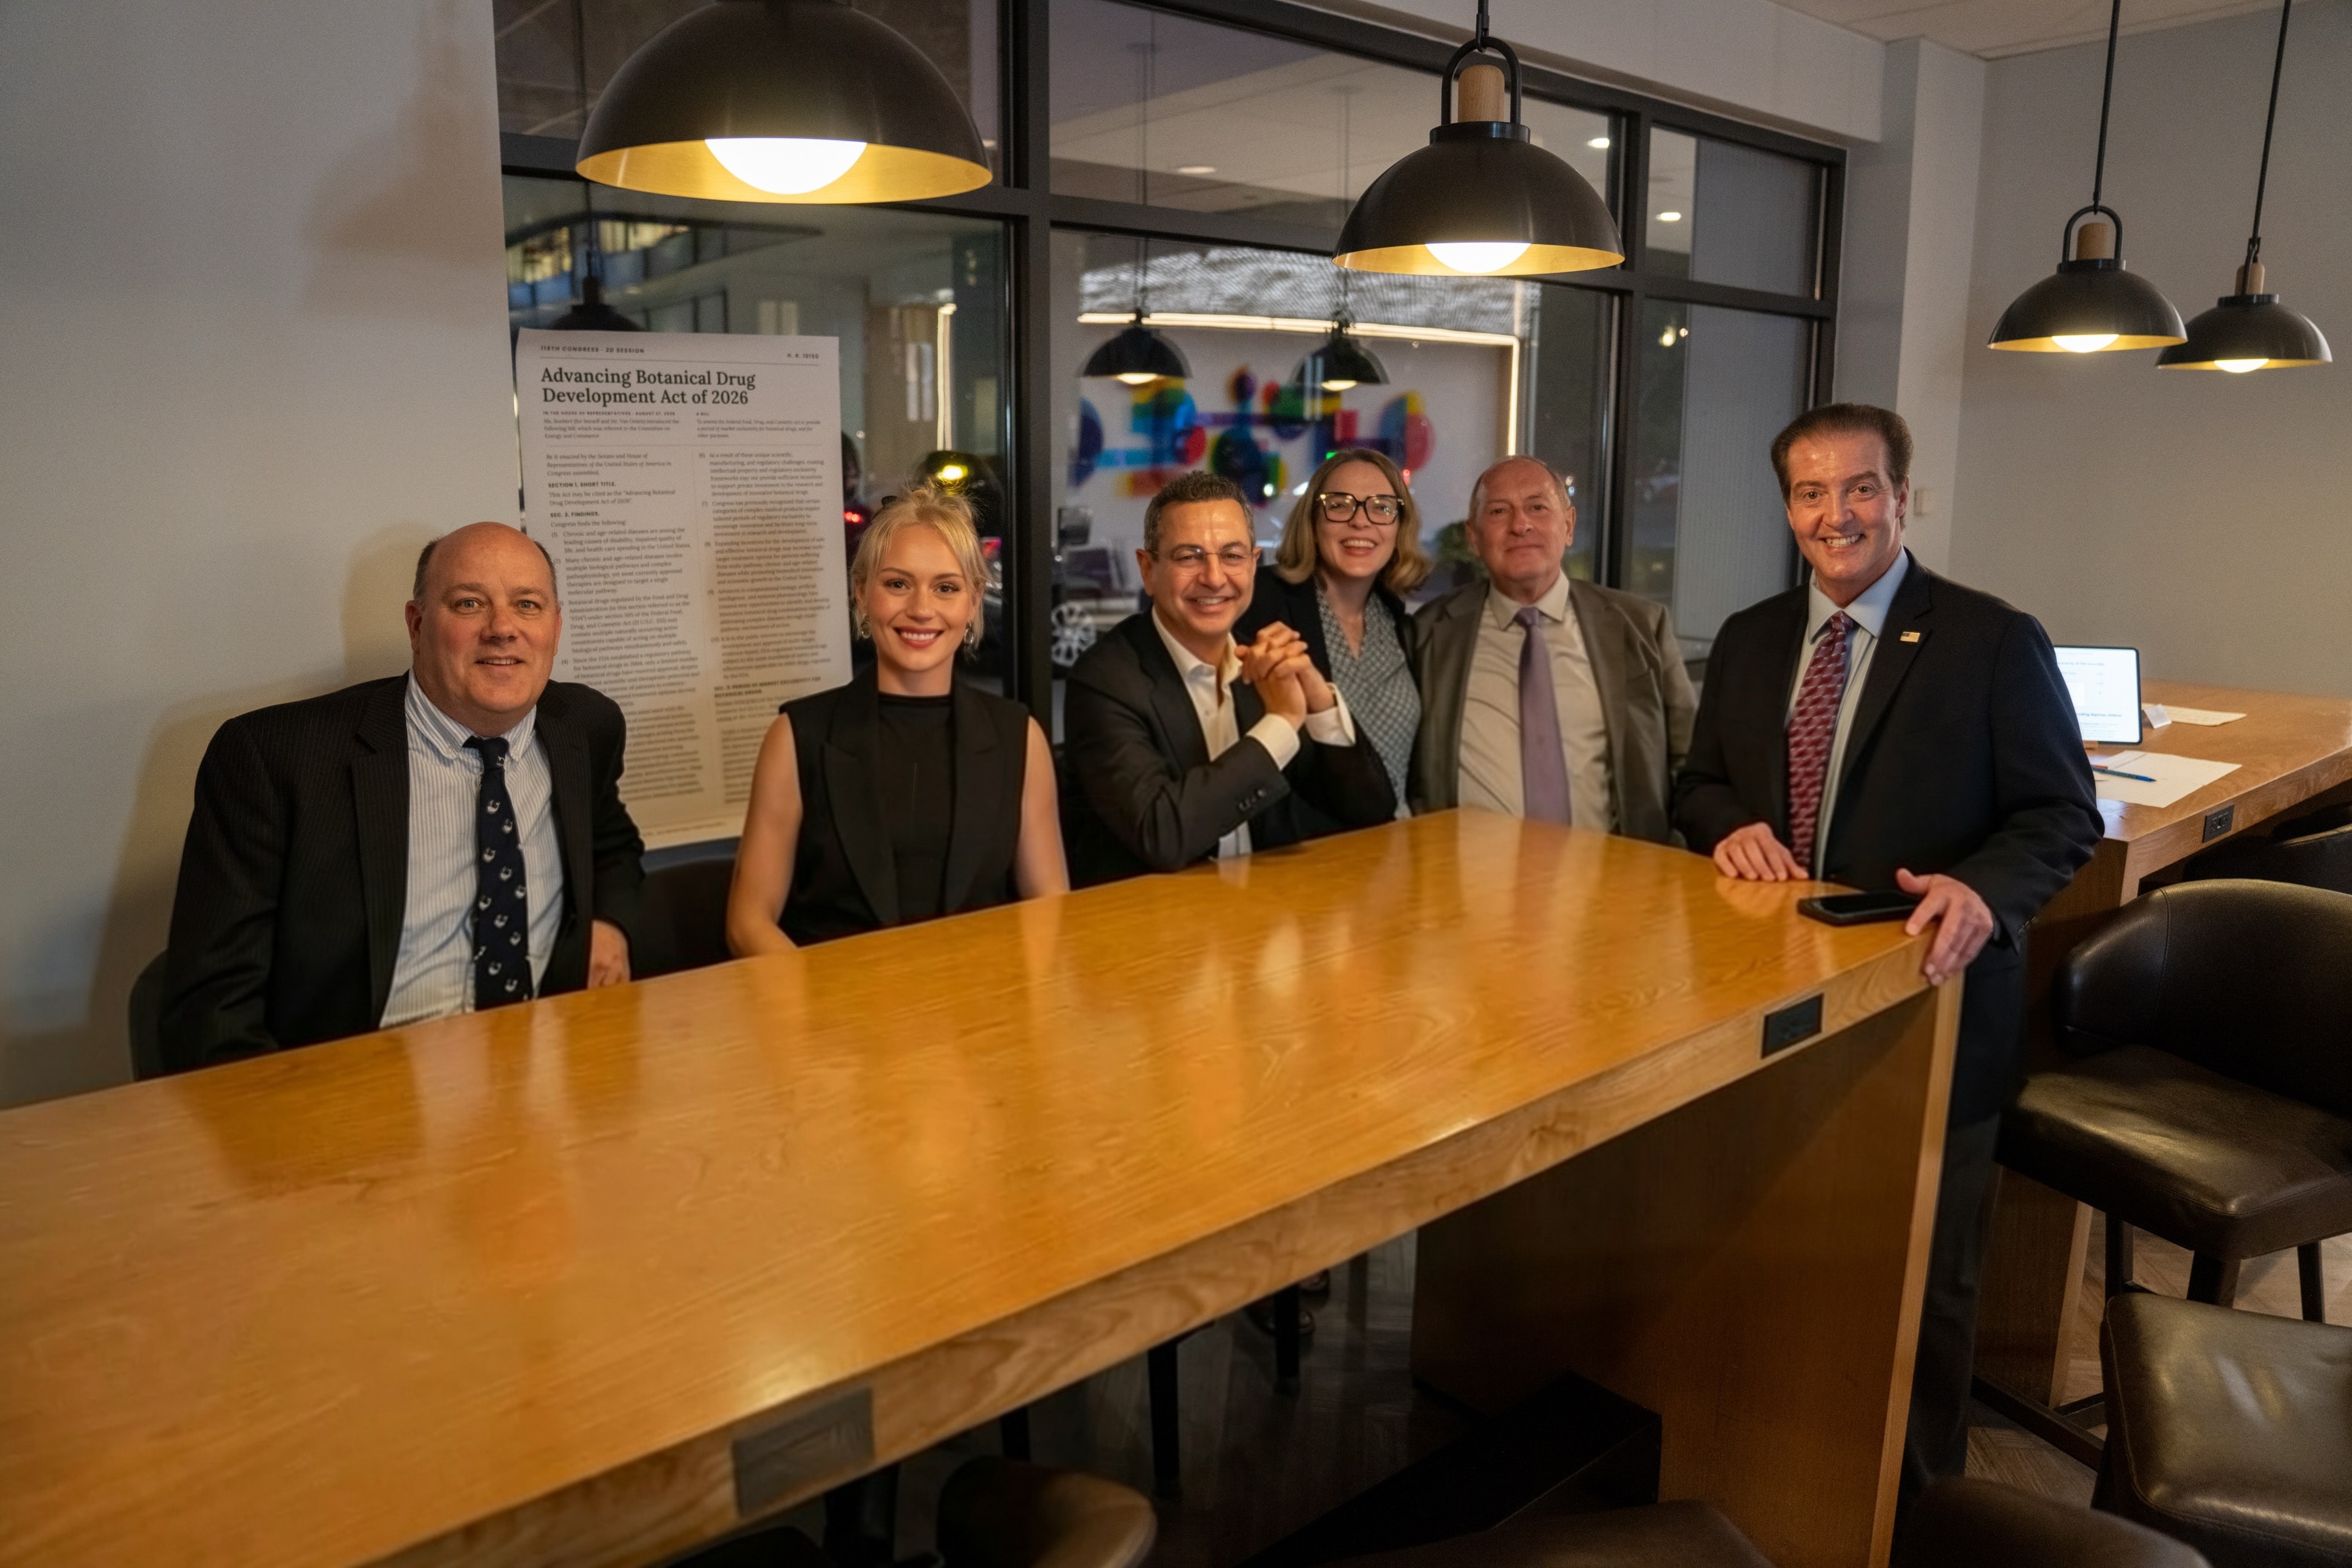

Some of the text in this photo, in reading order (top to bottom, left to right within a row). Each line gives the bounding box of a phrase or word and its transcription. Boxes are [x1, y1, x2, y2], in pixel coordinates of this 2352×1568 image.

[541, 367, 755, 391] Advancing Botanical Drug
[542, 388, 748, 408] Development Act of 2026
